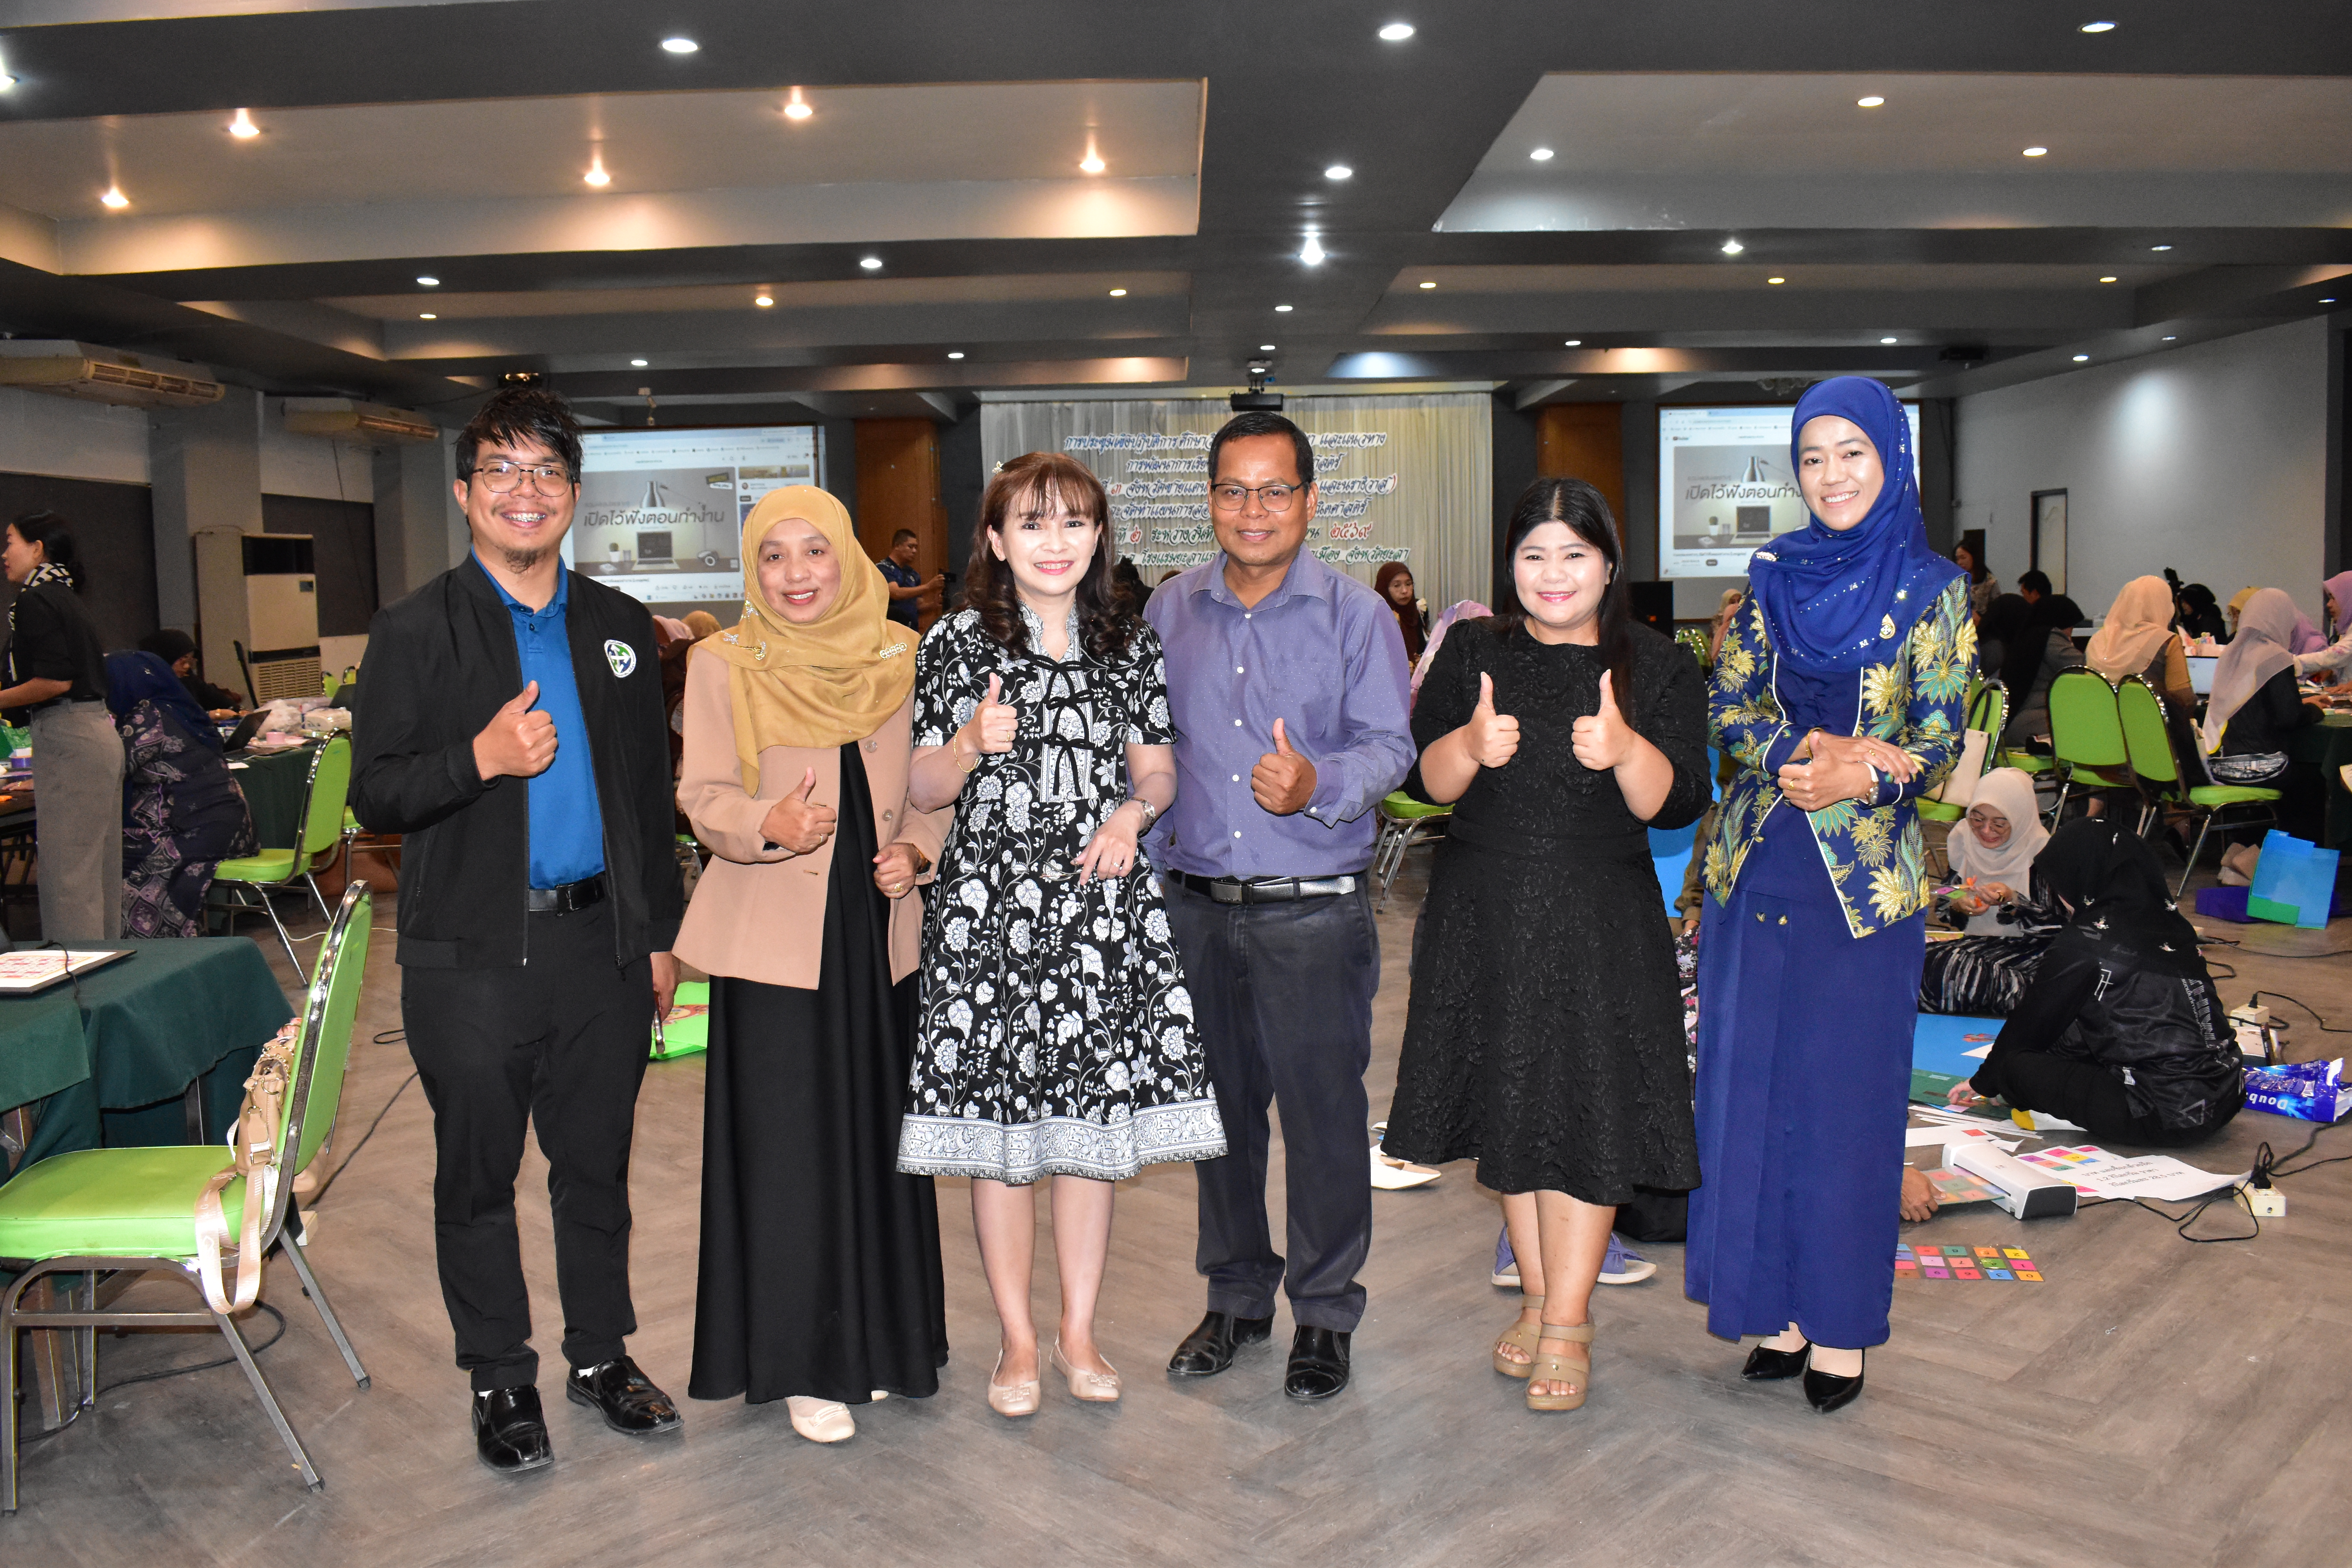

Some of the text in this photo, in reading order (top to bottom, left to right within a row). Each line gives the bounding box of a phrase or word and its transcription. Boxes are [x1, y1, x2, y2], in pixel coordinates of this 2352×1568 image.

[1314, 453, 1346, 472] าสตร์
[584, 507, 724, 526] เปิดไว้ฟังตอนทำงาน
[1346, 546, 1409, 563] จังหวัดยะลา
[2246, 1093, 2288, 1110] Doub
